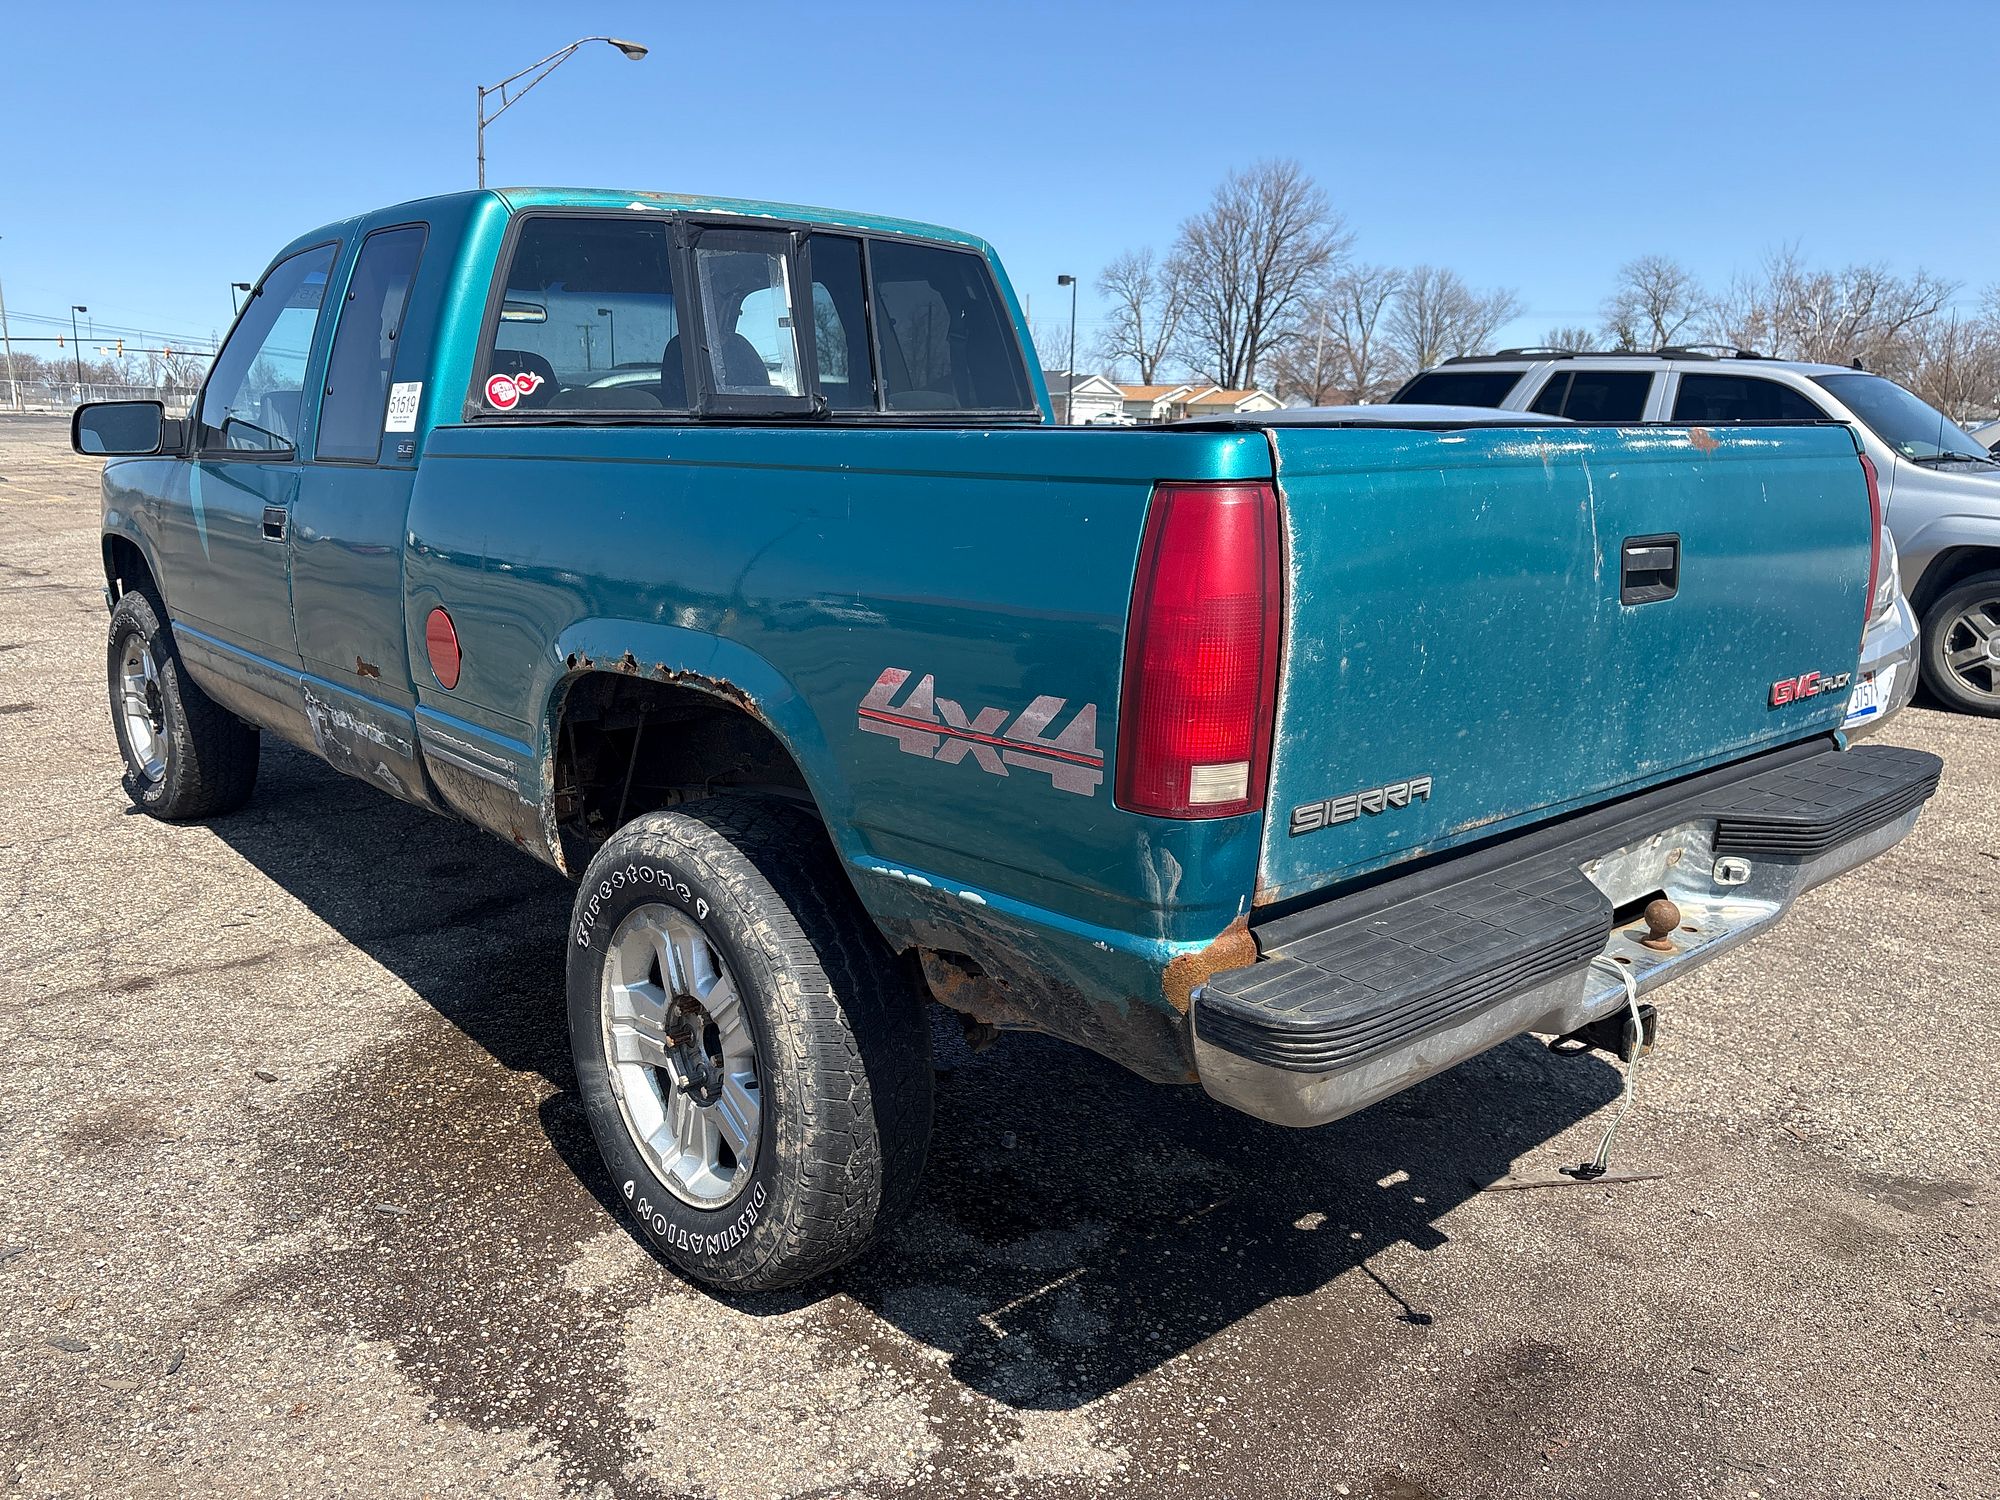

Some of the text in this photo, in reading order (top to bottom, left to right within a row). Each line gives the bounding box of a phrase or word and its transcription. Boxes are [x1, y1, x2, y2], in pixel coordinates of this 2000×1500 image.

[390, 395, 416, 414] 51519
[397, 444, 413, 453] SLE
[1771, 671, 1851, 706] GMC TRUCK
[1290, 775, 1432, 837] SIERRA
[577, 864, 691, 948] Firestone
[638, 1182, 767, 1255] DESTINATION
